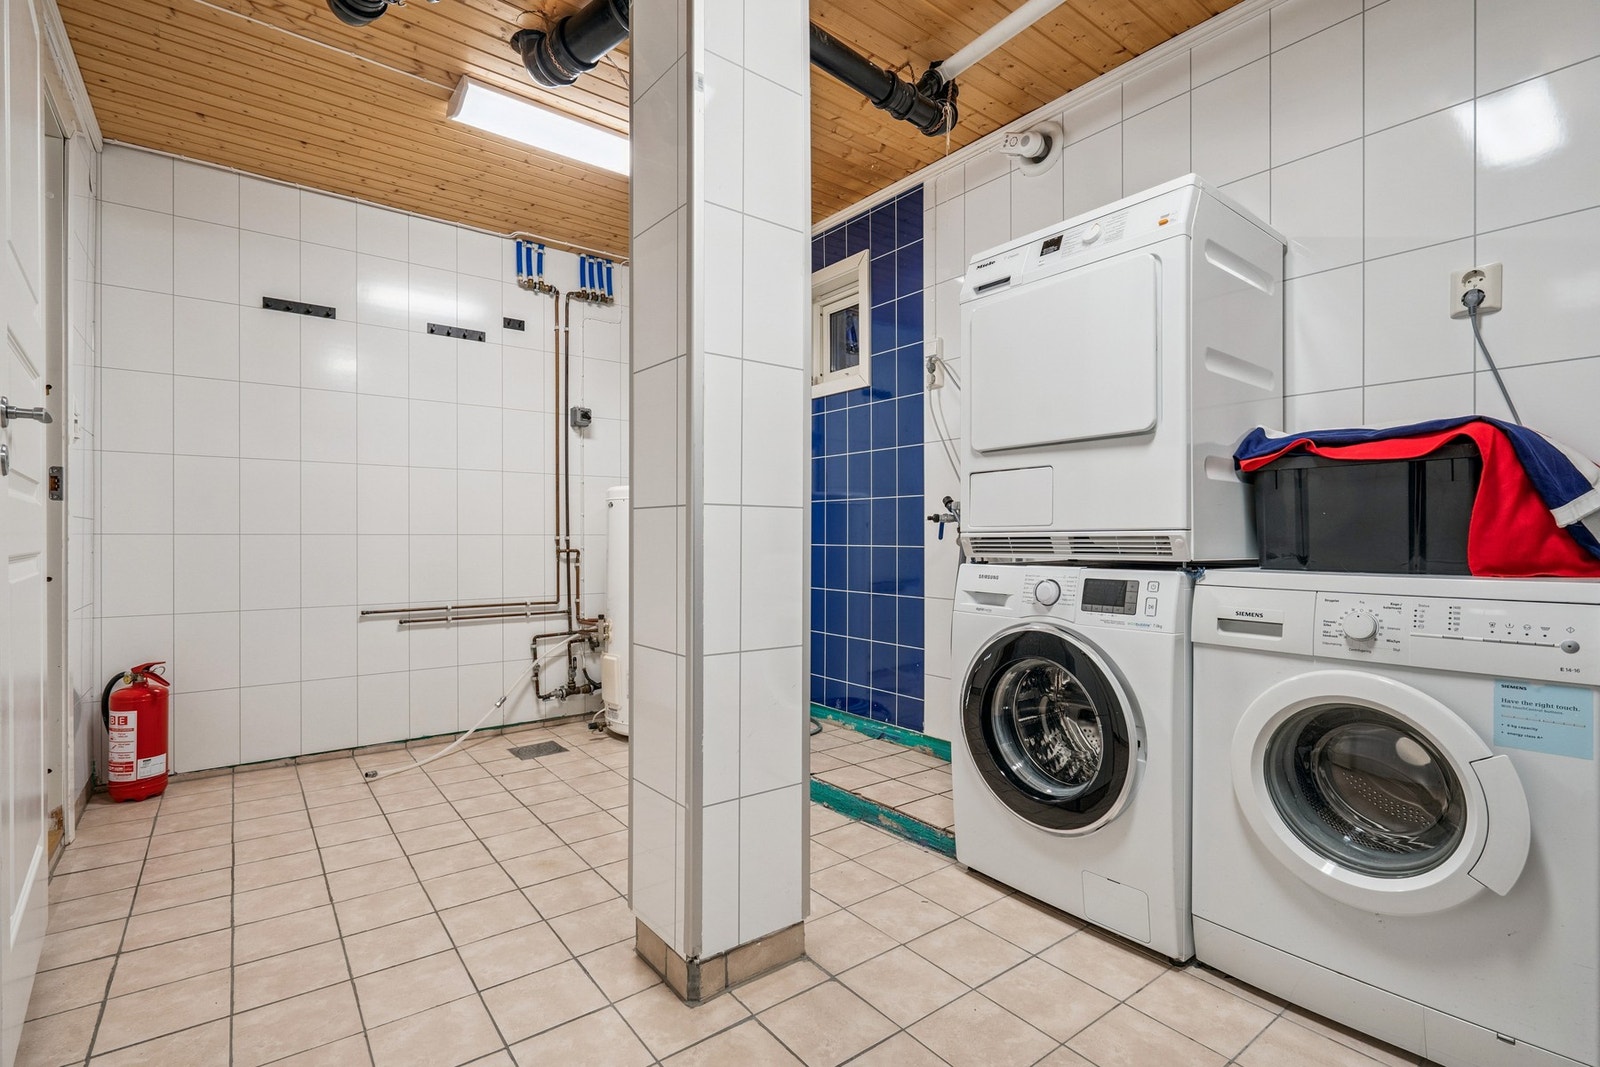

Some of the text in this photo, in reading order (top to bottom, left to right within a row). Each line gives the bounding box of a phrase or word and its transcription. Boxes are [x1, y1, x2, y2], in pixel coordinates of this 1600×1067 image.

[1235, 610, 1264, 618] SIEMENS
[1501, 697, 1519, 705] Have
[1534, 702, 1554, 710] right
[1555, 704, 1581, 712] touch.
